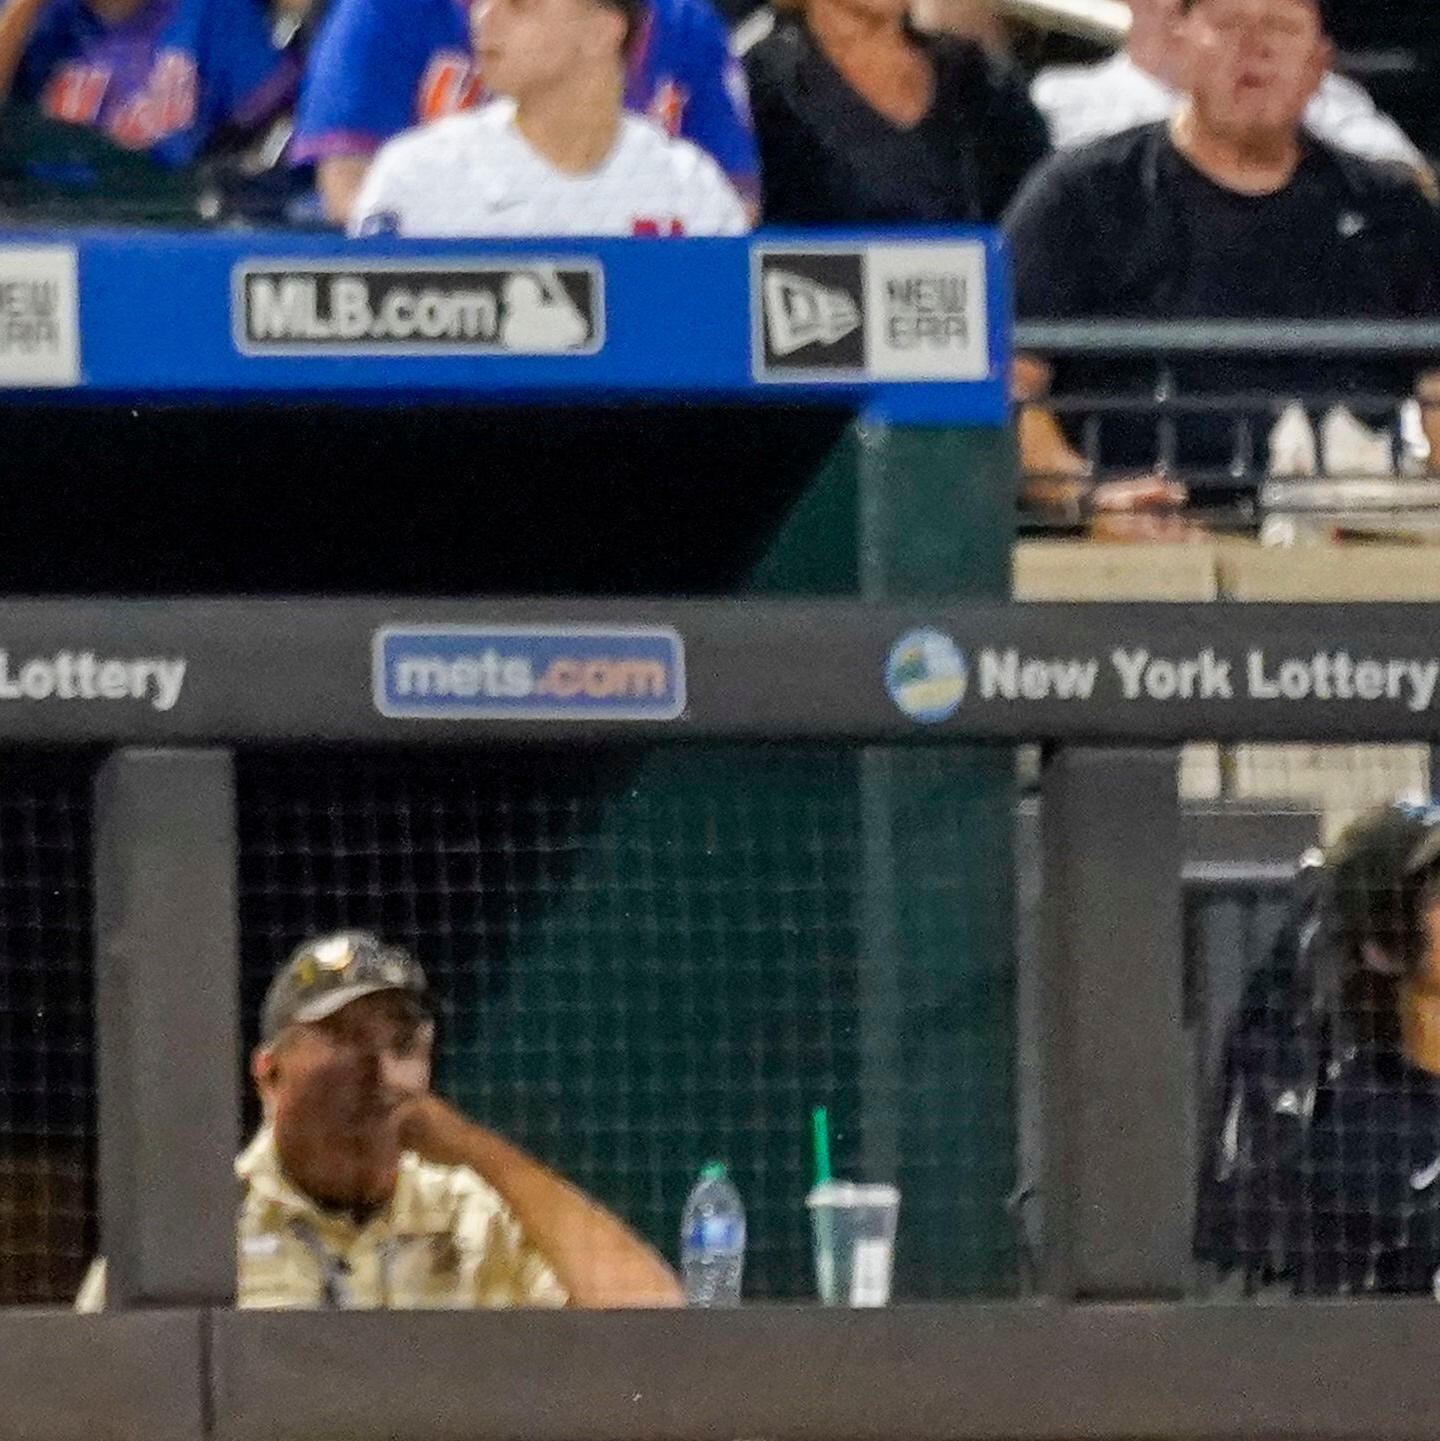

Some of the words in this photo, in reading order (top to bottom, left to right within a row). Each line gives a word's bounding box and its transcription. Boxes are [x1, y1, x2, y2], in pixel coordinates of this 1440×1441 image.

[250, 275, 498, 339] MLB.com
[886, 277, 968, 314] NEW
[394, 648, 668, 698] mets.com
[978, 647, 1099, 700] New
[1111, 645, 1234, 700] York
[1246, 647, 1440, 713] Lottery
